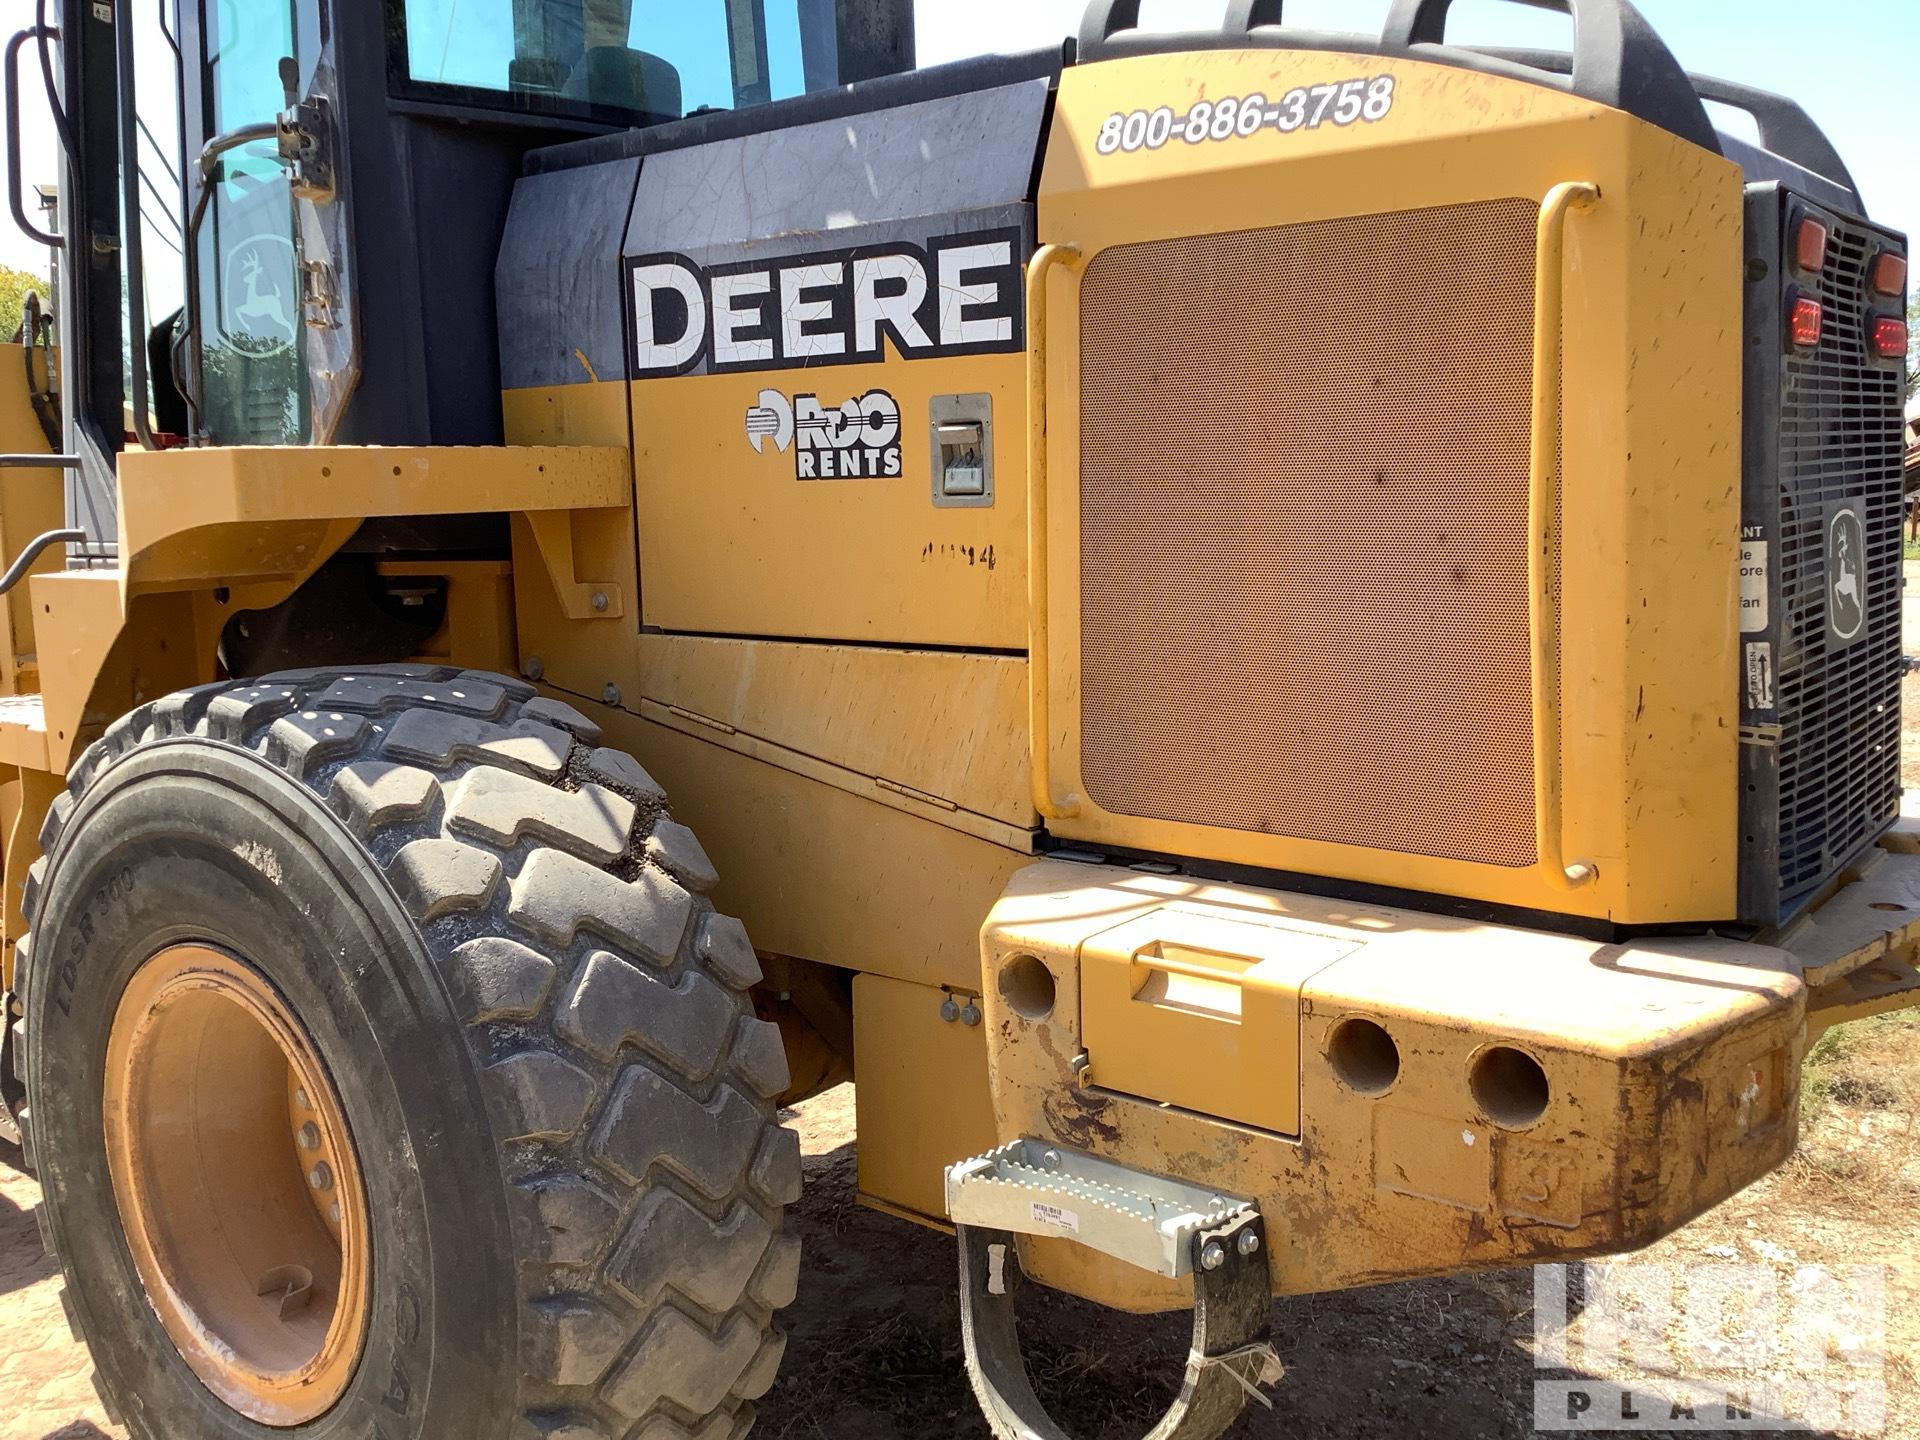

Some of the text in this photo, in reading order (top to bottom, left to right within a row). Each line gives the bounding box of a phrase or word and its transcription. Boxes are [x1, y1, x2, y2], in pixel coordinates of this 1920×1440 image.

[1097, 75, 1395, 154] 800-886-3758
[633, 241, 1013, 369] DEERE
[796, 393, 899, 449] RDO
[798, 448, 900, 478] RENTS
